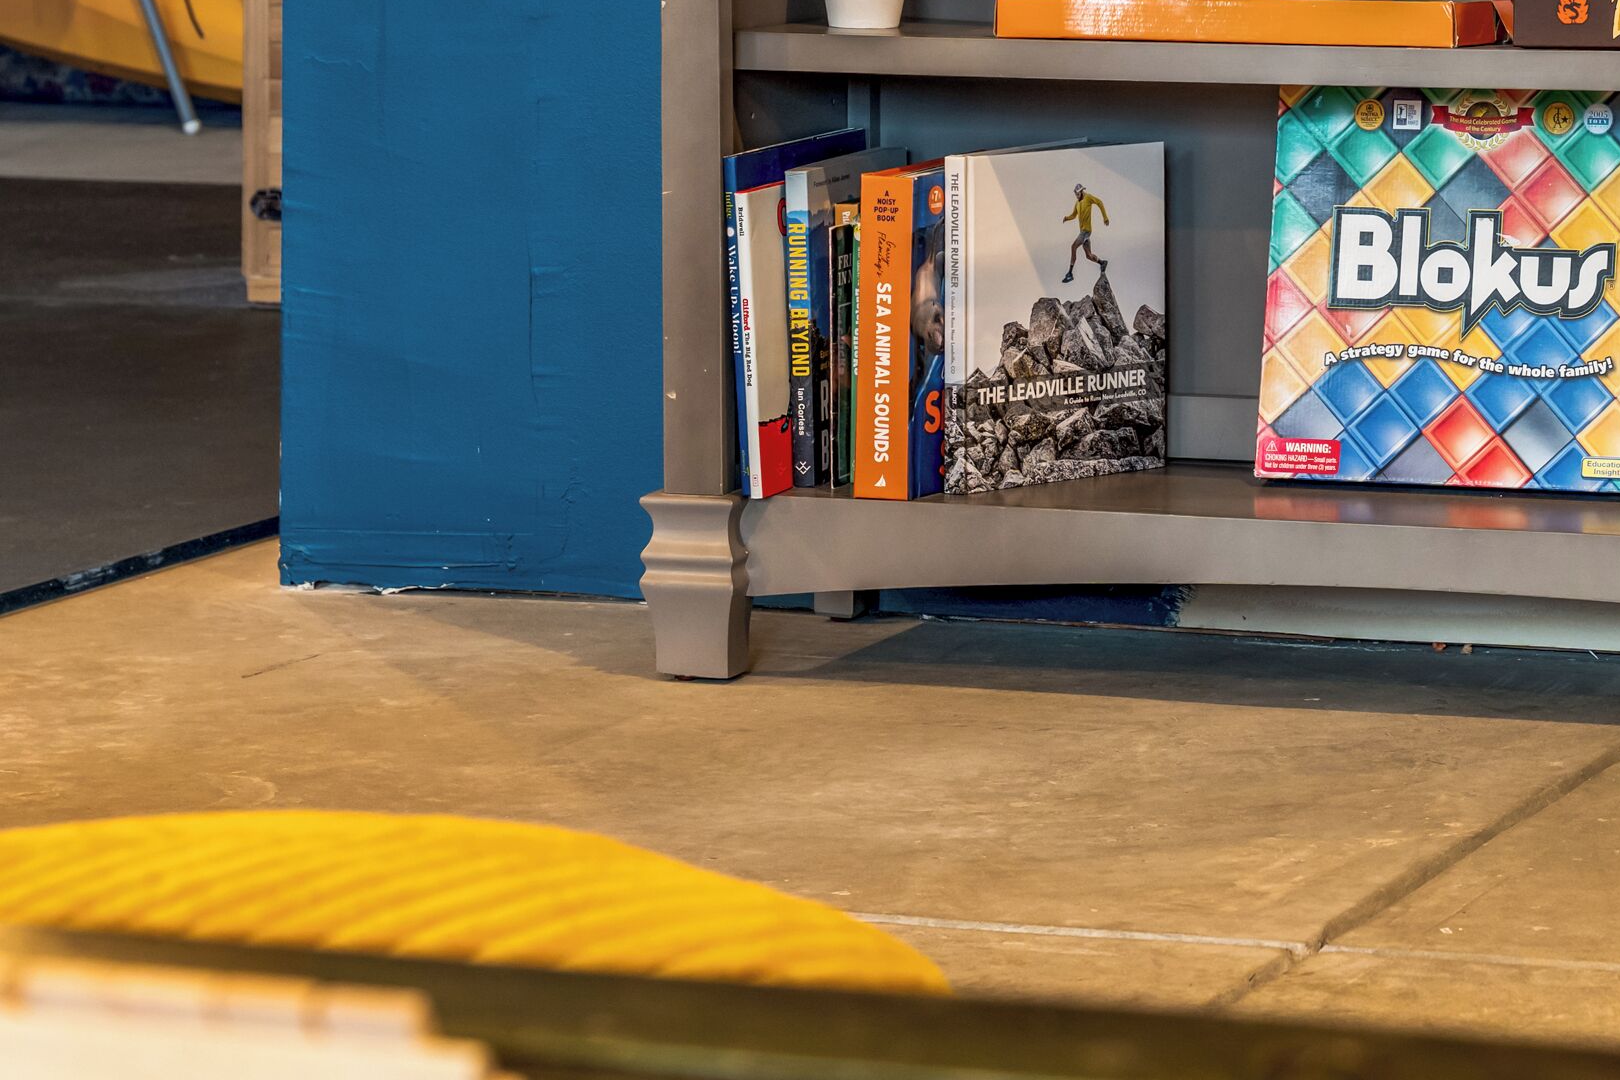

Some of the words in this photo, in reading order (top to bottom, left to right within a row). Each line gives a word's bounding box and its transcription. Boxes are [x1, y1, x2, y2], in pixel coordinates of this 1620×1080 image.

[1449, 115, 1458, 123] The
[1459, 117, 1472, 125] Most
[1472, 118, 1500, 126] Celebrated
[951, 173, 959, 192] THE
[873, 206, 899, 214] POP-UP
[877, 214, 895, 222] BOOK
[951, 194, 959, 246] LEADVILLE
[788, 223, 808, 300] RUNNING
[951, 247, 959, 288] RUNNER
[1332, 208, 1612, 322] Blokus
[727, 245, 736, 282] Wake
[732, 311, 742, 354] Moon!
[742, 298, 750, 331] Clifford
[876, 282, 892, 318] SEA
[789, 308, 811, 377] BEYOND
[874, 322, 891, 389] ANIMAL
[1324, 353, 1337, 366] A
[1339, 344, 1404, 360] strategy
[1407, 344, 1449, 359] game
[1452, 350, 1476, 367] for
[1478, 358, 1503, 373] the
[1508, 365, 1555, 378] whole
[1558, 357, 1613, 379] family!
[797, 387, 805, 402] Ian
[977, 385, 1006, 405] THE
[1008, 376, 1084, 402] LEADVILLE
[1087, 369, 1146, 392] RUNNER
[1069, 397, 1084, 405] Guide
[797, 403, 805, 436] Corless
[873, 392, 890, 463] SOUNDS
[1285, 442, 1332, 454] WARNING:
